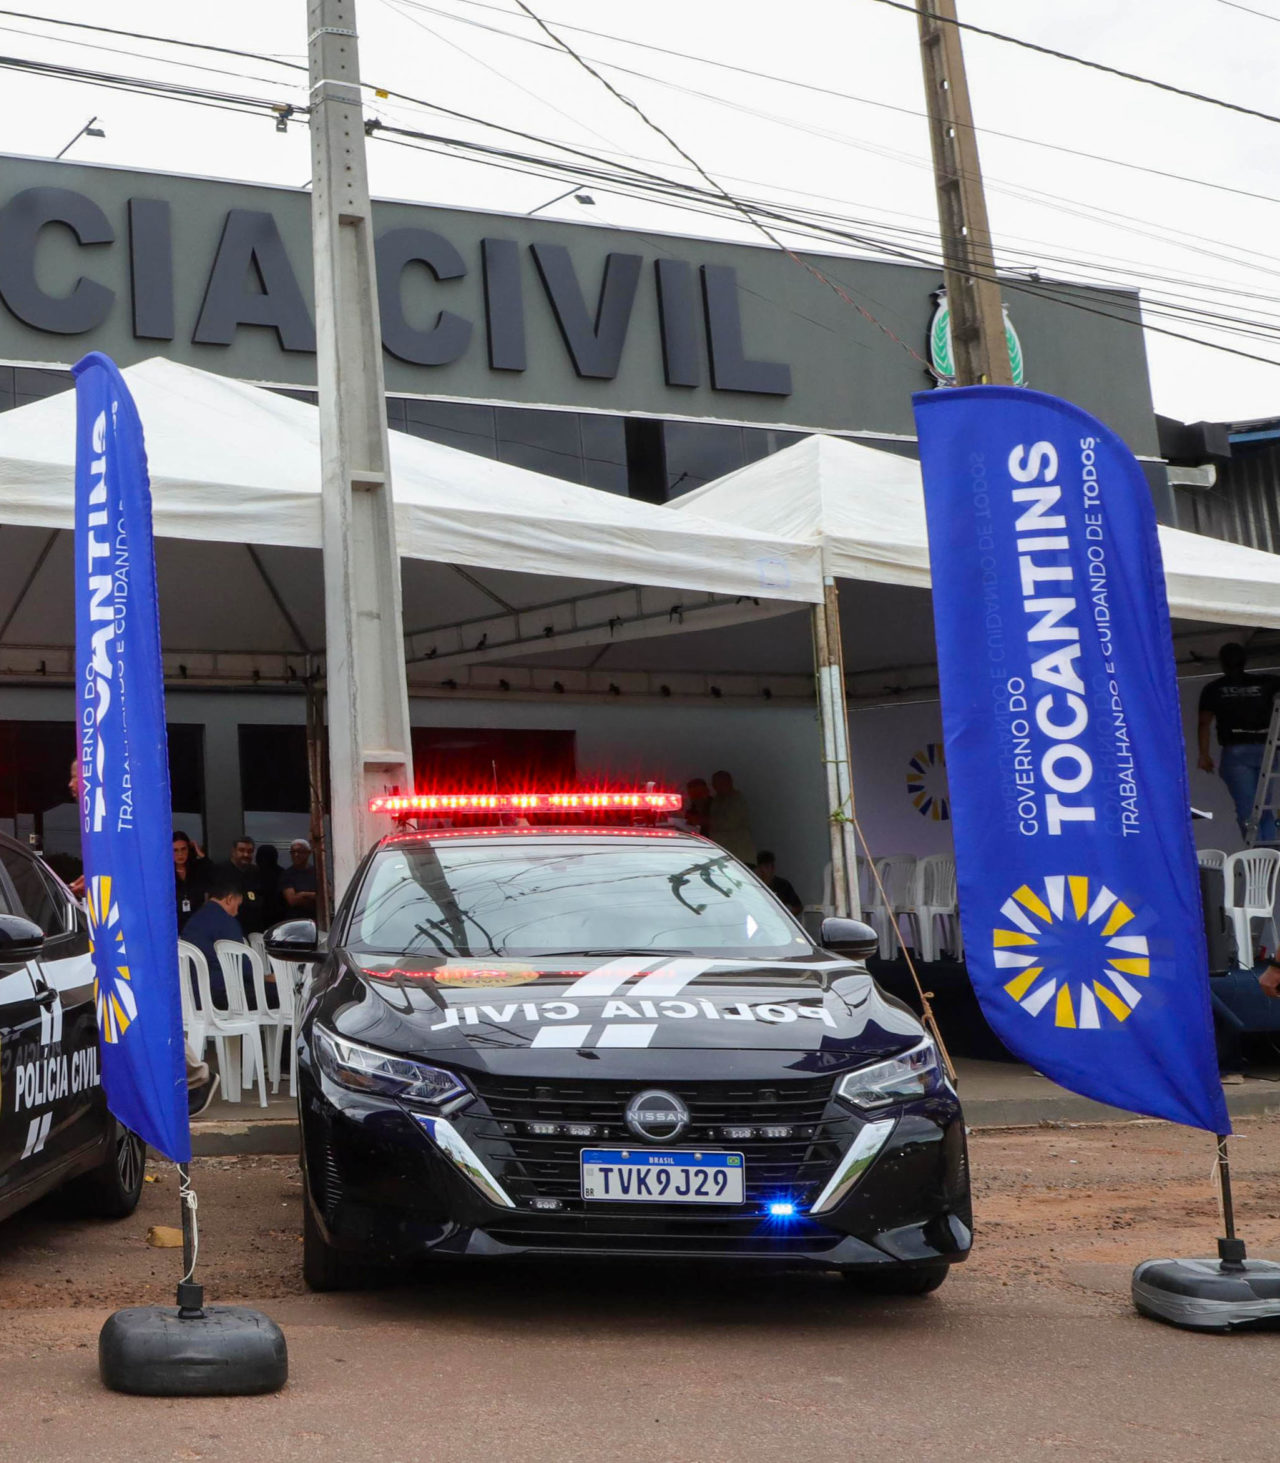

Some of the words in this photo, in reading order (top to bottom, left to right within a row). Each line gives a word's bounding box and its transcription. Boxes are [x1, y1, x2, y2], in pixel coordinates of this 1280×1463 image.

[375, 228, 792, 397] CIVIL
[1080, 437, 1101, 508] TODOS
[1084, 513, 1103, 540] DE
[1087, 546, 1113, 656] CUIDANDO
[1008, 440, 1096, 836] TOCANTINS
[1105, 661, 1115, 674] E
[84, 661, 96, 700] DO
[1007, 677, 1028, 712] DO
[81, 707, 96, 834] GOVERNO
[1011, 719, 1039, 836] GOVERNO
[1109, 680, 1140, 838] TRABALHANDO
[15, 1047, 68, 1112] POLÍCIA
[72, 1047, 100, 1094] CIVIL
[628, 1112, 688, 1121] NISSAN
[585, 1188, 594, 1197] BR
[598, 1167, 728, 1196] TVK9J29
